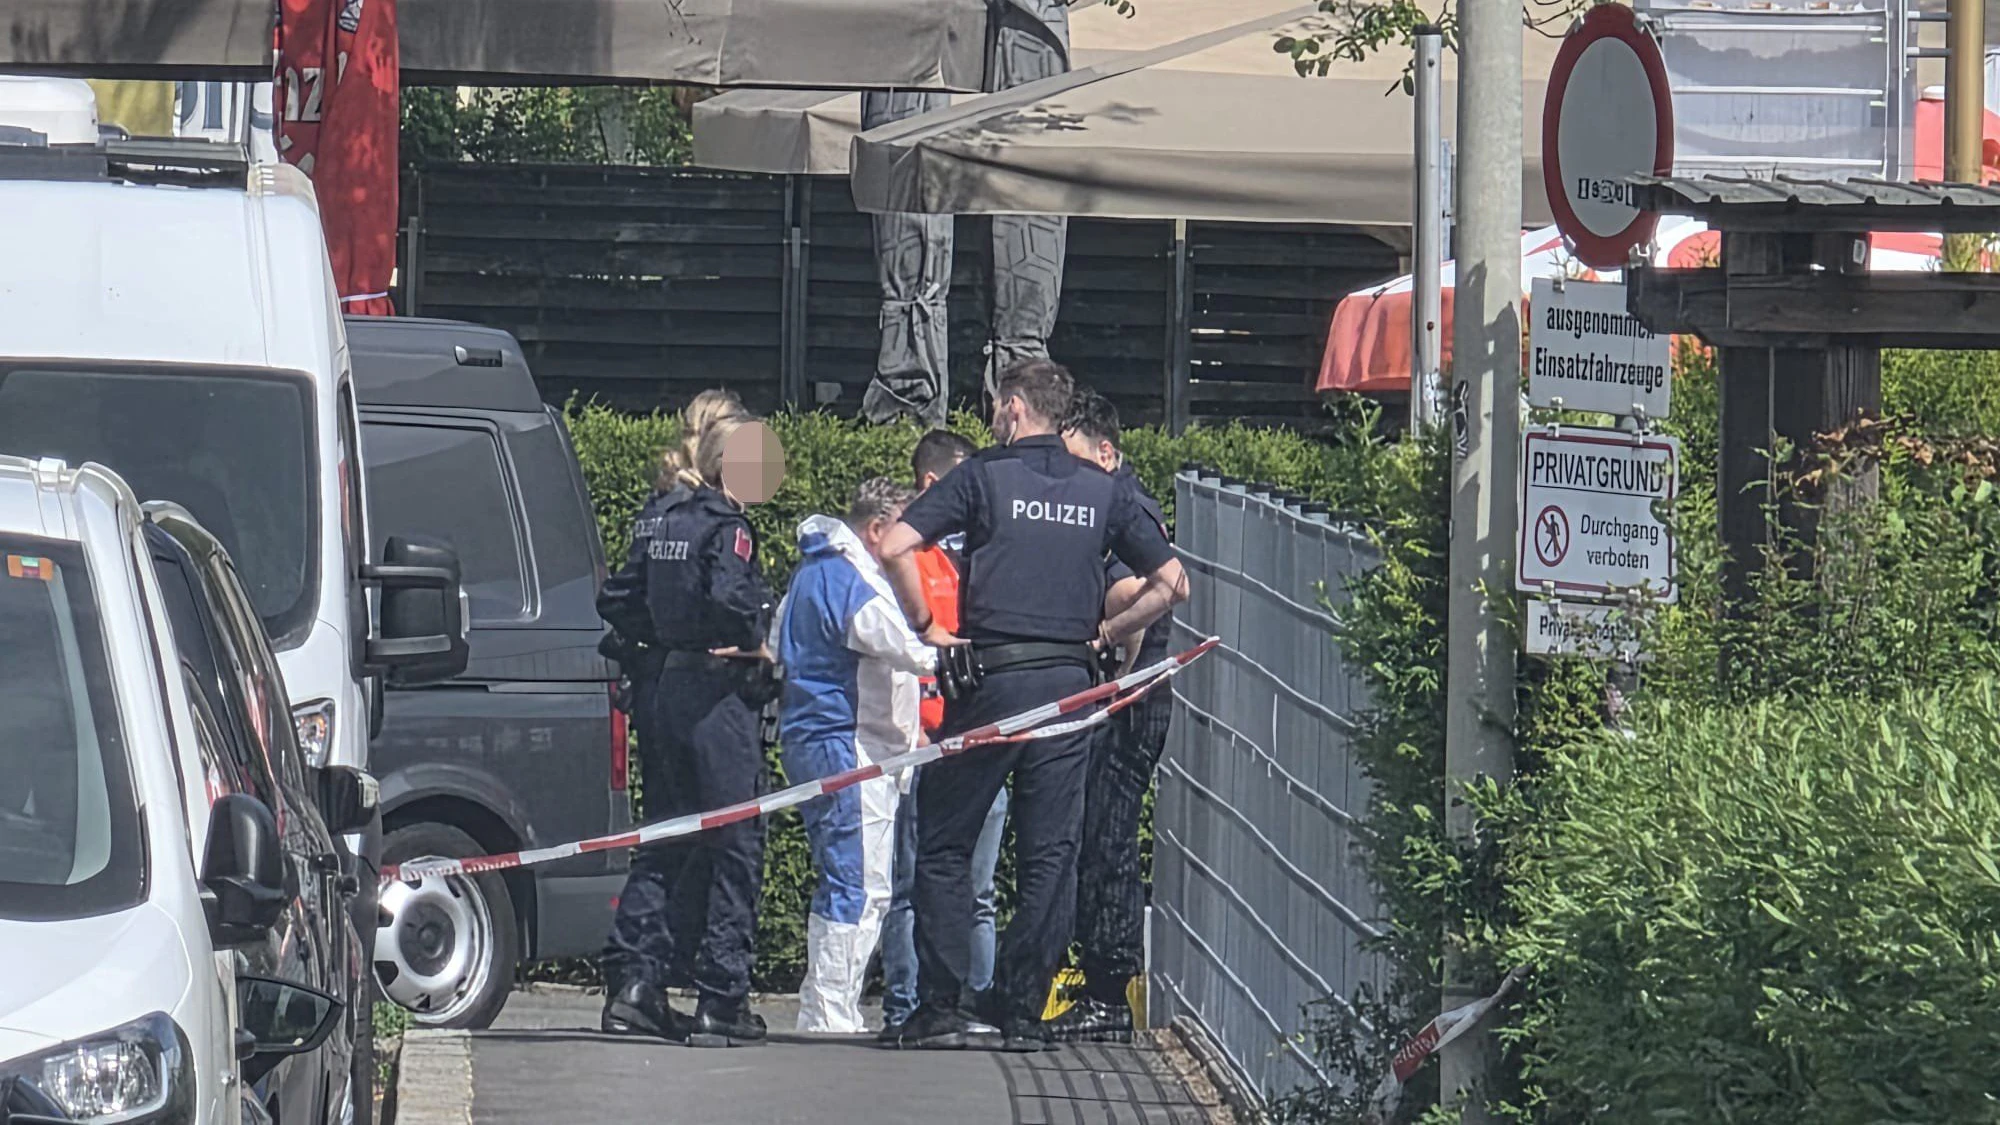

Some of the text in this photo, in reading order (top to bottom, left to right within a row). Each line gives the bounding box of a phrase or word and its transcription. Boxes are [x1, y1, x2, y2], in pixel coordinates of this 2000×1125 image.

[1535, 346, 1664, 393] Einsatzfahrzeuge
[1532, 451, 1664, 493] PRIVATGRUND
[1012, 499, 1095, 528] POLIZEI
[1580, 514, 1659, 546] Durchgang
[1586, 546, 1649, 570] verboten
